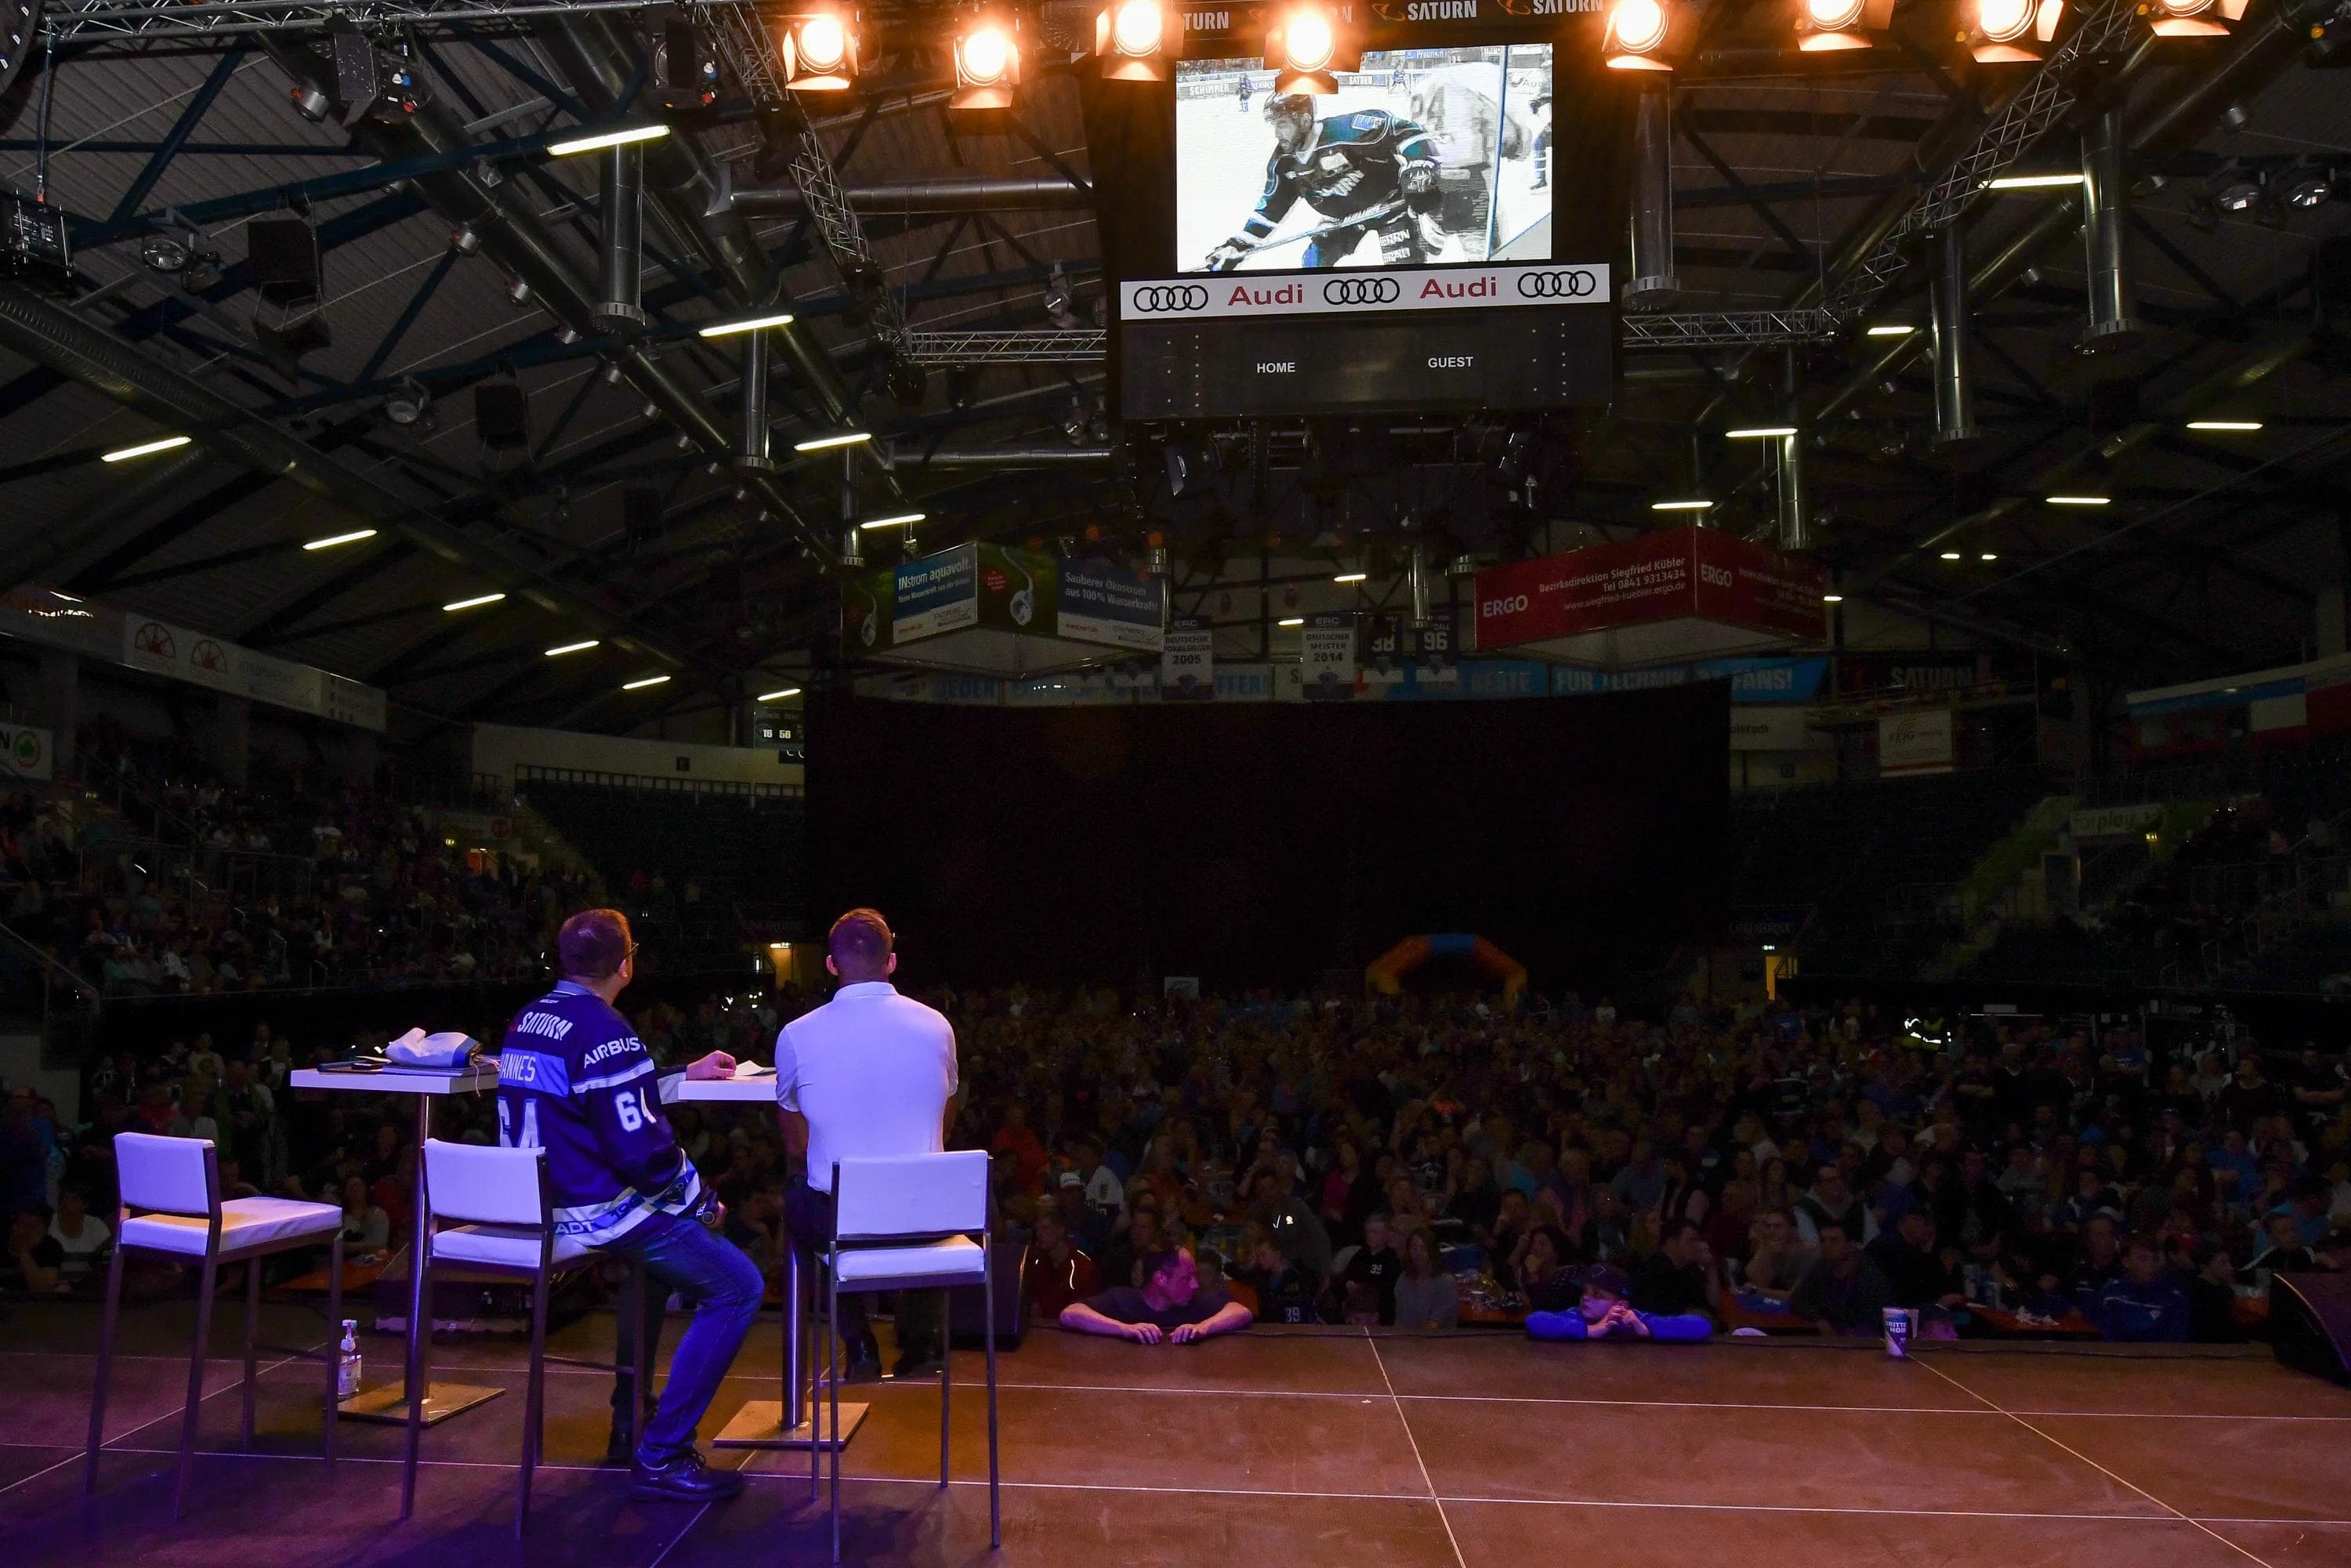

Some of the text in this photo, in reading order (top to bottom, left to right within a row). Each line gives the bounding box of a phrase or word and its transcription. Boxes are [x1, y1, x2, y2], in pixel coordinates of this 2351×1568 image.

[1407, 0, 1478, 21] SATURN
[1181, 10, 1230, 31] TURN
[1227, 277, 1498, 306] Audi Audi
[1255, 361, 1295, 374] HOME
[1427, 356, 1474, 369] GUEST
[898, 573, 928, 591] INstrom
[1065, 572, 1104, 589] Sauberer
[1538, 557, 1686, 593] Bezirksdirektion Siegfried Kübler
[1701, 563, 1733, 588] ERGO
[1065, 589, 1080, 598] aus
[1603, 581, 1616, 592] Tel
[1617, 579, 1641, 591] 0841
[1482, 595, 1529, 618] ERGO
[1316, 616, 1340, 625] ERC
[1165, 636, 1208, 644] DEUTSCHER
[1306, 633, 1350, 642] DEUTSCHER
[1310, 642, 1346, 650] MEISTER
[1423, 631, 1448, 651] 96
[1172, 654, 1201, 665] 2005
[1313, 652, 1343, 662] 2014
[517, 1011, 574, 1041] SATURN
[584, 1036, 640, 1070] AIRBUS
[501, 1053, 536, 1082] ANNES
[552, 1221, 595, 1236] ADT
